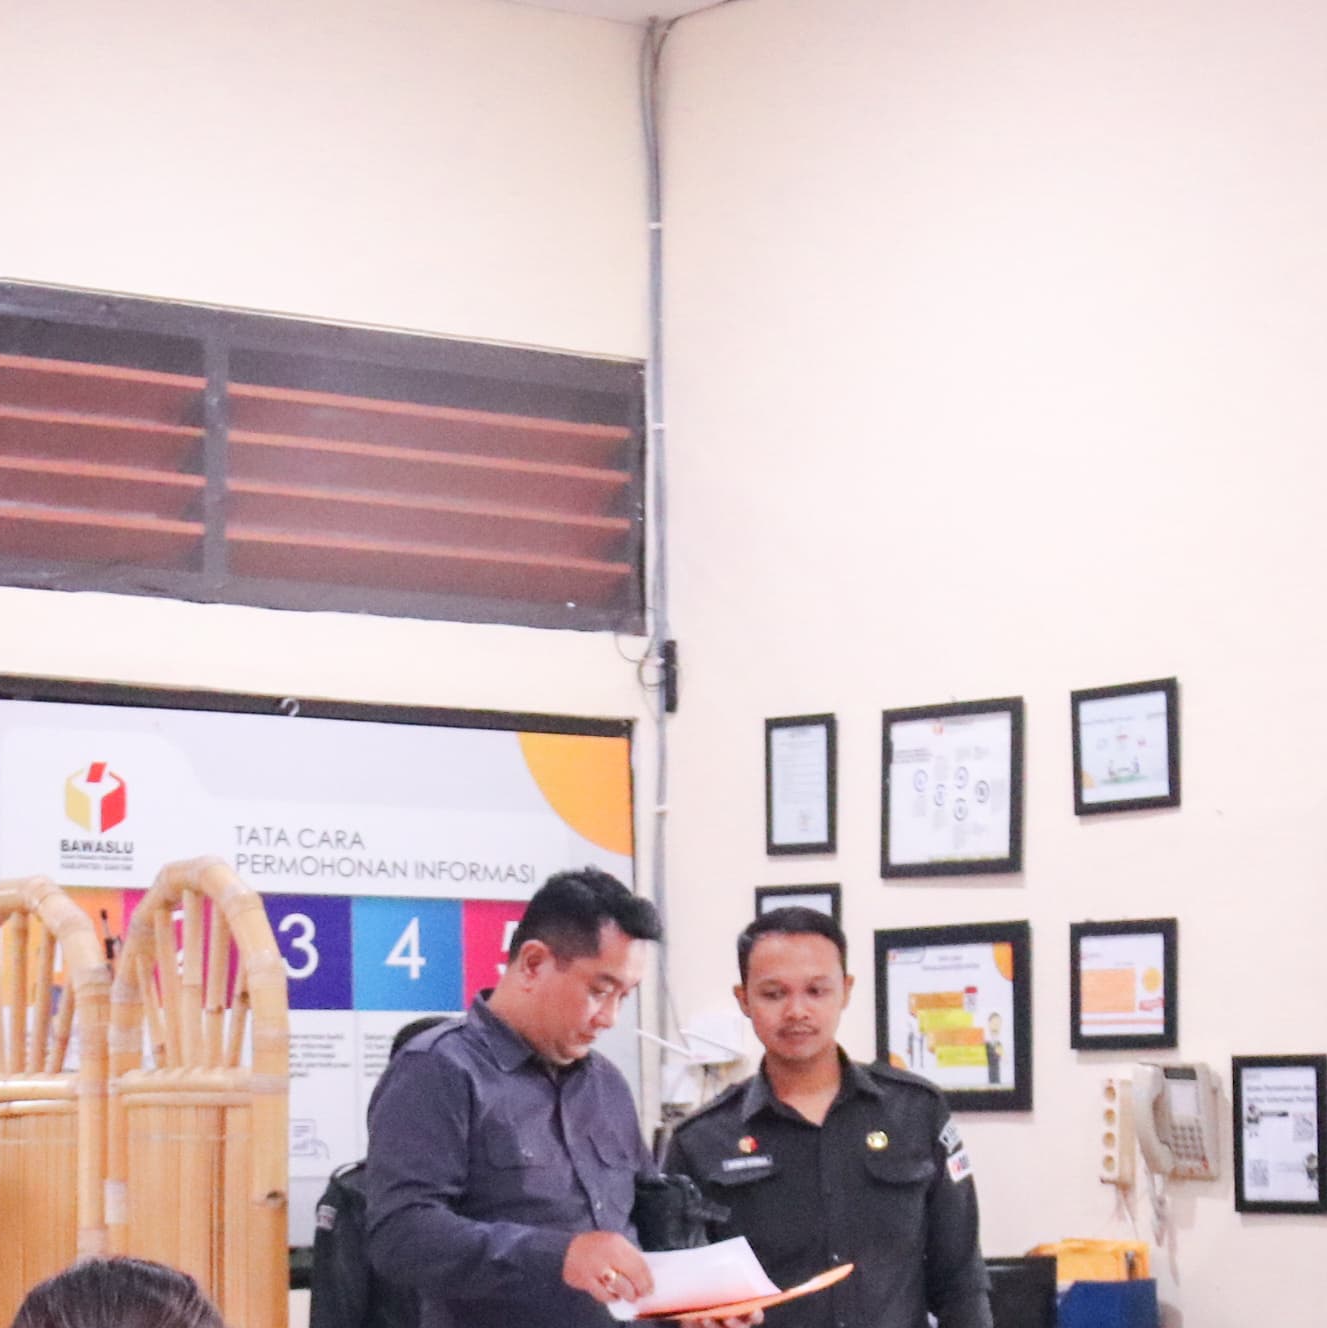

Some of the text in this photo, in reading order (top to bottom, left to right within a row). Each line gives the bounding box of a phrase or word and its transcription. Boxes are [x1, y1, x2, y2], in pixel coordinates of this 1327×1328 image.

[60, 839, 134, 854] BAWASLU
[235, 825, 366, 851] TATA CARA
[236, 853, 536, 884] PERMOHONAN INFORMASI
[277, 912, 319, 979] 3
[384, 916, 427, 981] 4
